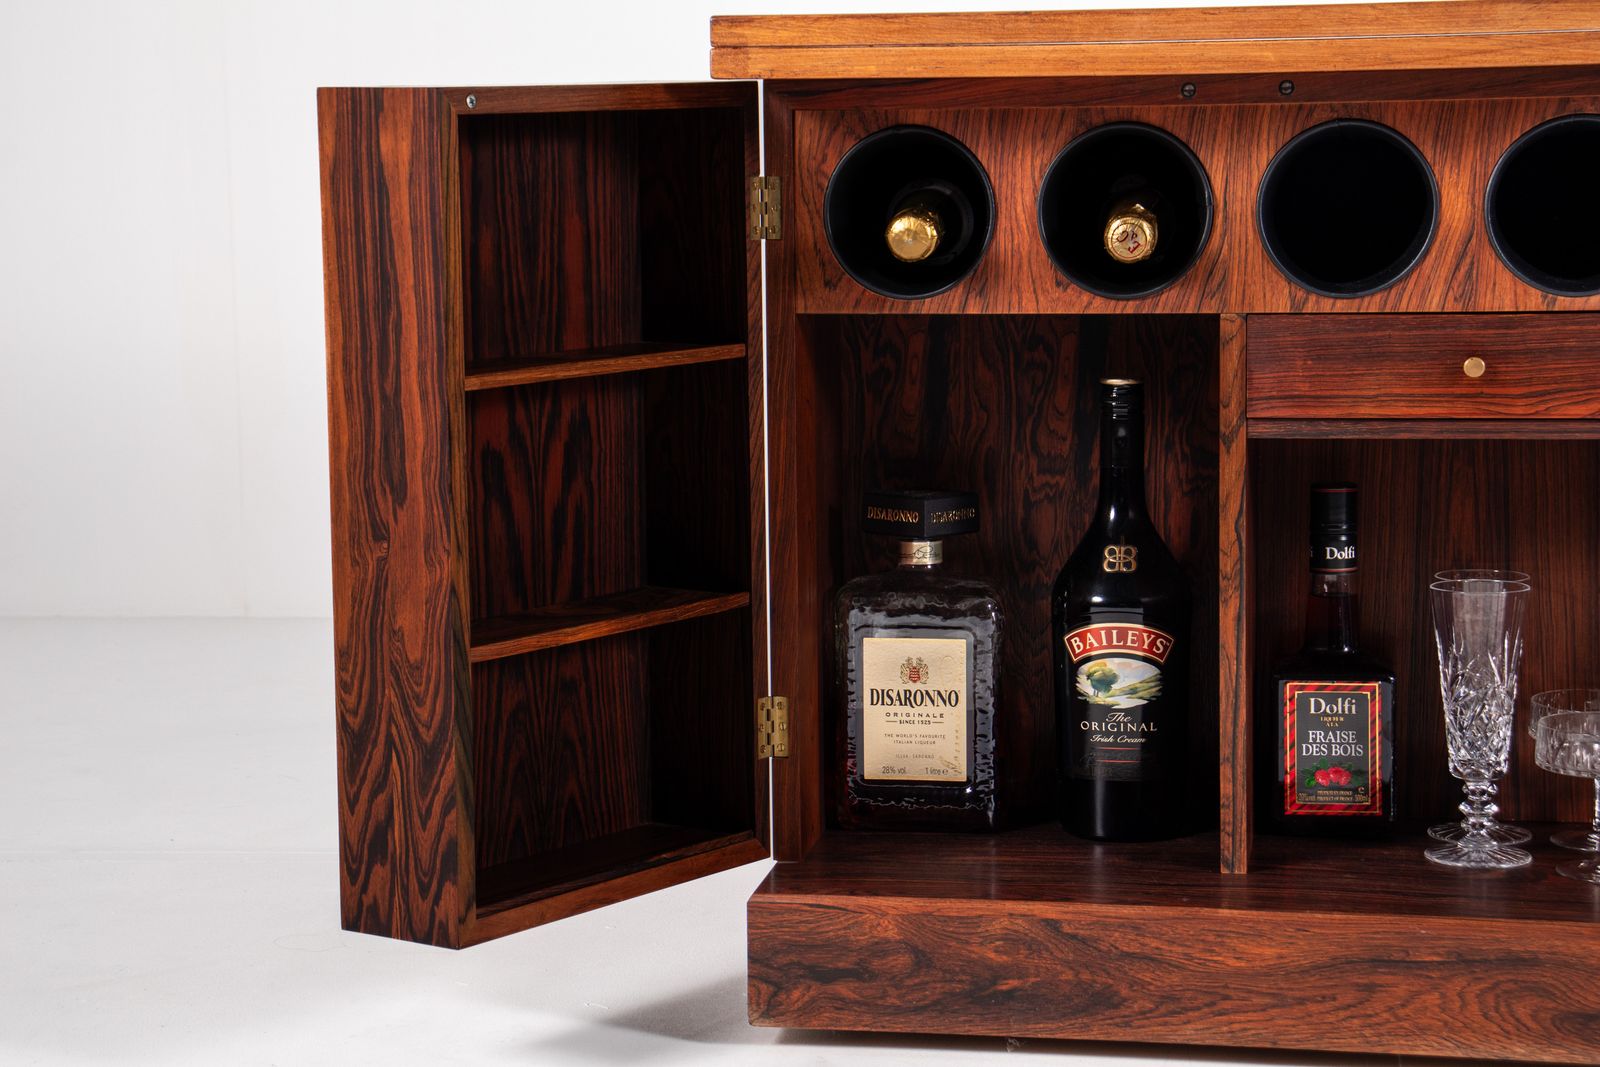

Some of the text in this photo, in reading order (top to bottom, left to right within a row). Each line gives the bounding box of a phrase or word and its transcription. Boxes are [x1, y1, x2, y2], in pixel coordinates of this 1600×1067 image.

[867, 506, 919, 523] DISARONNO
[1325, 546, 1355, 560] Dolfi
[1070, 629, 1169, 654] BAILEYS
[870, 688, 959, 709] DISARONNO
[1310, 697, 1357, 715] Dolfi
[1105, 712, 1133, 722] The
[1080, 721, 1157, 732] ORIGINAL
[1090, 735, 1146, 744] Irish Cream
[1308, 730, 1357, 744] FRAISE
[1302, 743, 1364, 757] DES BOIS
[881, 765, 907, 775] 28% vol
